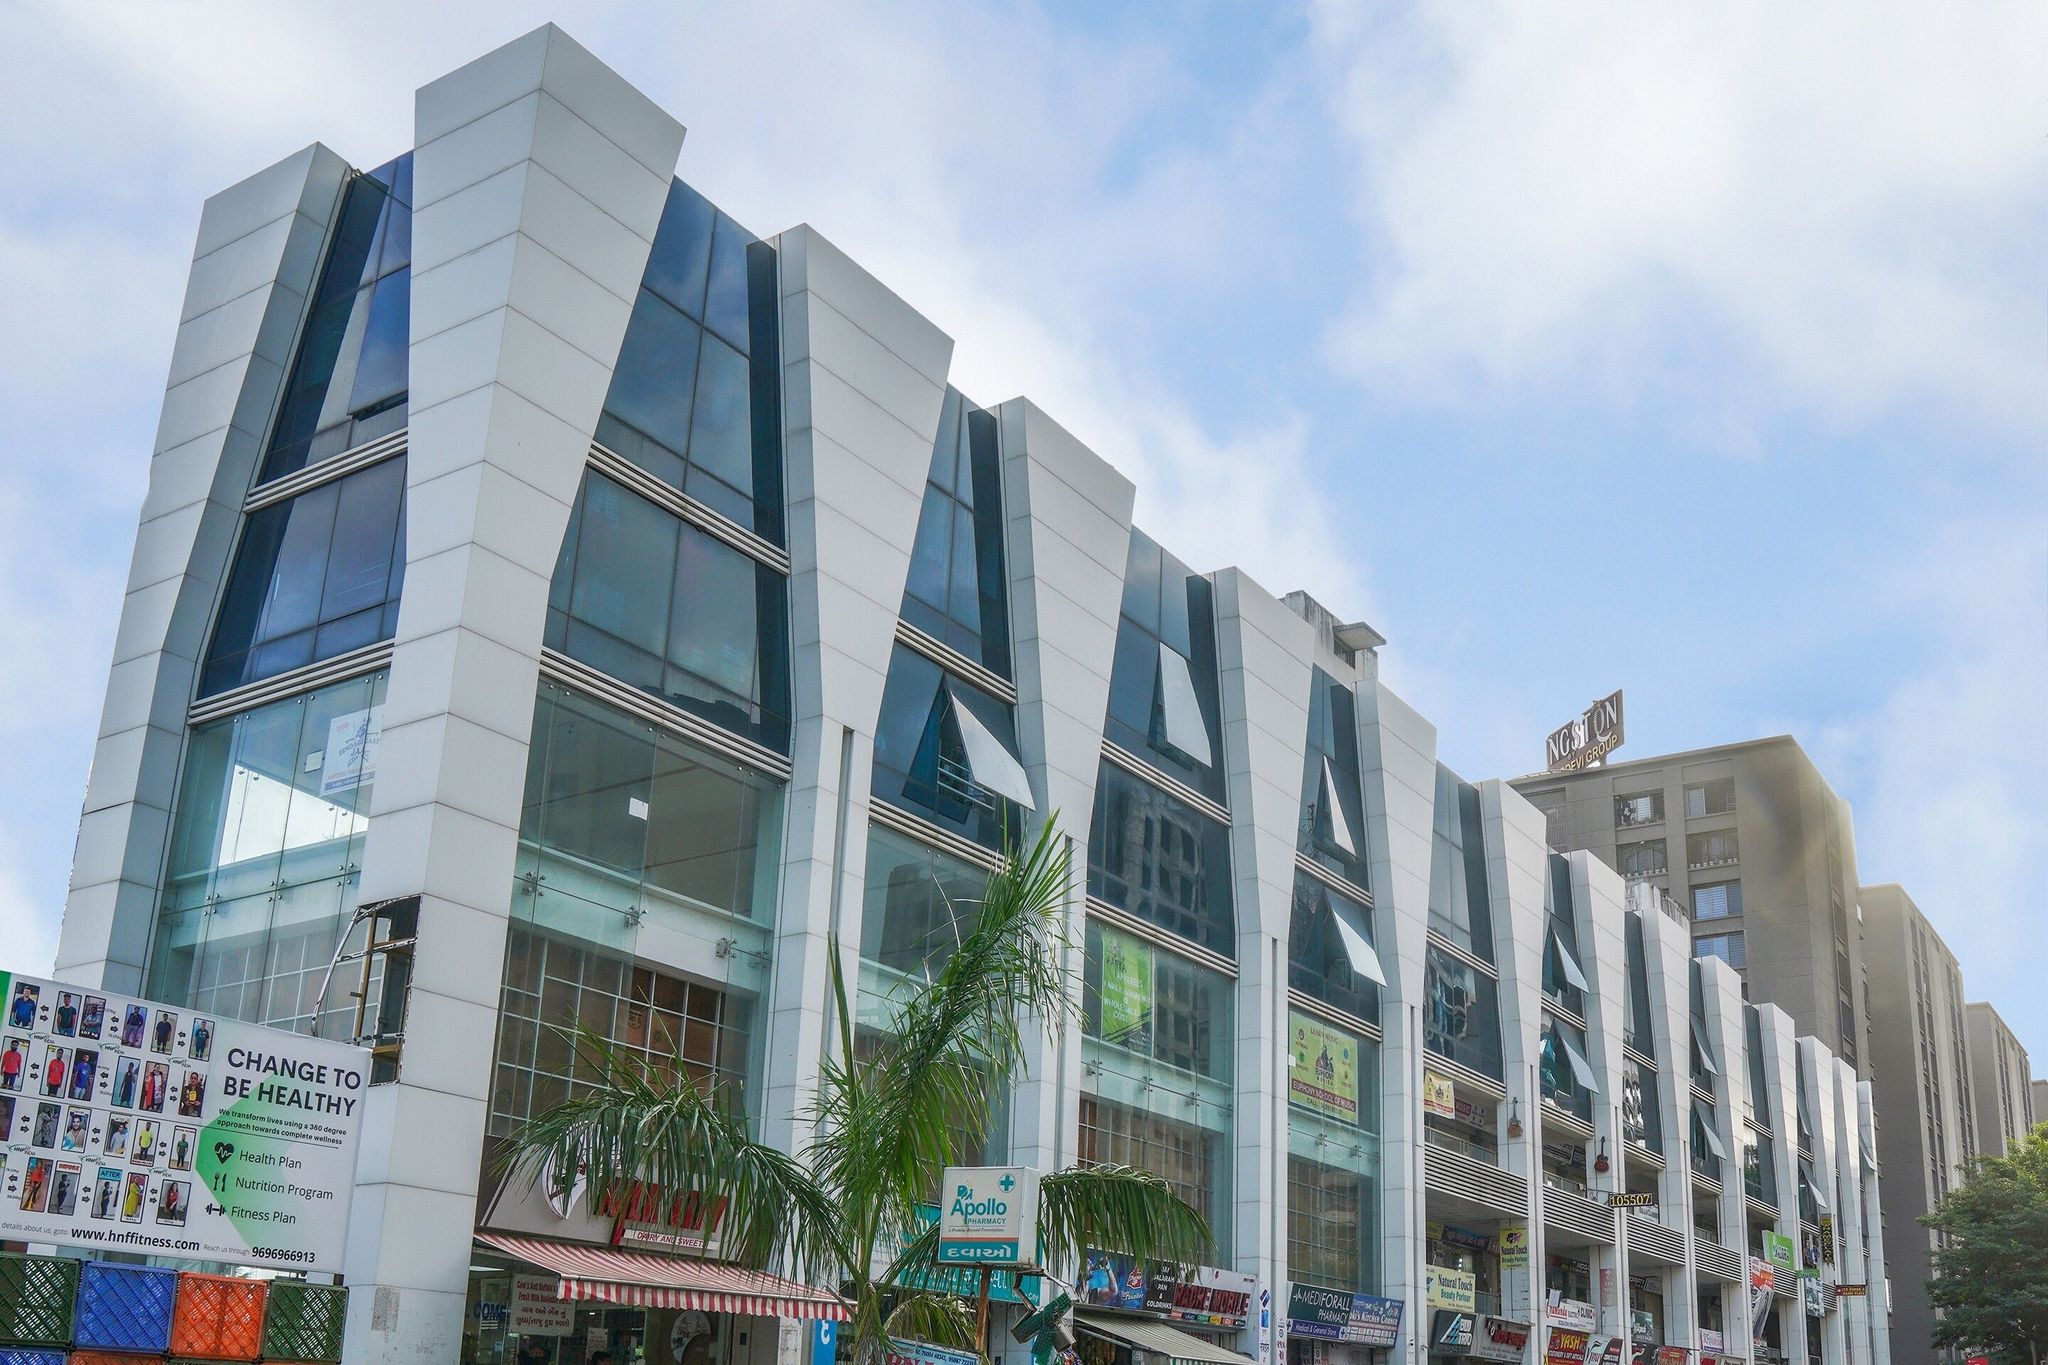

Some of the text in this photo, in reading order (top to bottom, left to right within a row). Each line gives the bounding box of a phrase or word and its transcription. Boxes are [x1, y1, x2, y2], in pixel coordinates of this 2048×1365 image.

[1586, 735, 1617, 763] GROUP
[227, 1048, 361, 1090] CHANGE TO
[224, 1076, 357, 1117] BE HEALTHY
[218, 1108, 230, 1116] We
[231, 1110, 266, 1122] transform
[266, 1116, 283, 1125] lives
[284, 1120, 303, 1129] using
[309, 1123, 322, 1131] 360
[323, 1125, 347, 1136] degree
[217, 1120, 342, 1145] approach towards complete wellness
[239, 1150, 302, 1169] Health Plan
[100, 1170, 121, 1179] AFTER
[235, 1177, 333, 1200] Nutrition Program
[230, 1206, 296, 1224] Fitness Plan
[950, 1198, 1007, 1225] Apollo
[23, 1224, 42, 1234] about
[53, 1228, 68, 1237] goto
[71, 1228, 200, 1251] www.hnffitness.com
[203, 1243, 220, 1252] Reach
[228, 1246, 250, 1256] through
[252, 1246, 315, 1263] 9696966913
[637, 1232, 660, 1241] DAIRY
[660, 1235, 675, 1243] AND
[947, 1244, 1012, 1258] દવાઓ
[1438, 1274, 1473, 1291] Natural Touch
[1146, 1300, 1172, 1309] COLDRINKS
[1301, 1290, 1350, 1311] MEDIFORALL
[1318, 1309, 1349, 1324] PHARMACY
[1295, 1324, 1309, 1333] Medical
[1313, 1326, 1327, 1335] General
[1327, 1328, 1337, 1336] Store
[1560, 1334, 1580, 1350] YASH
